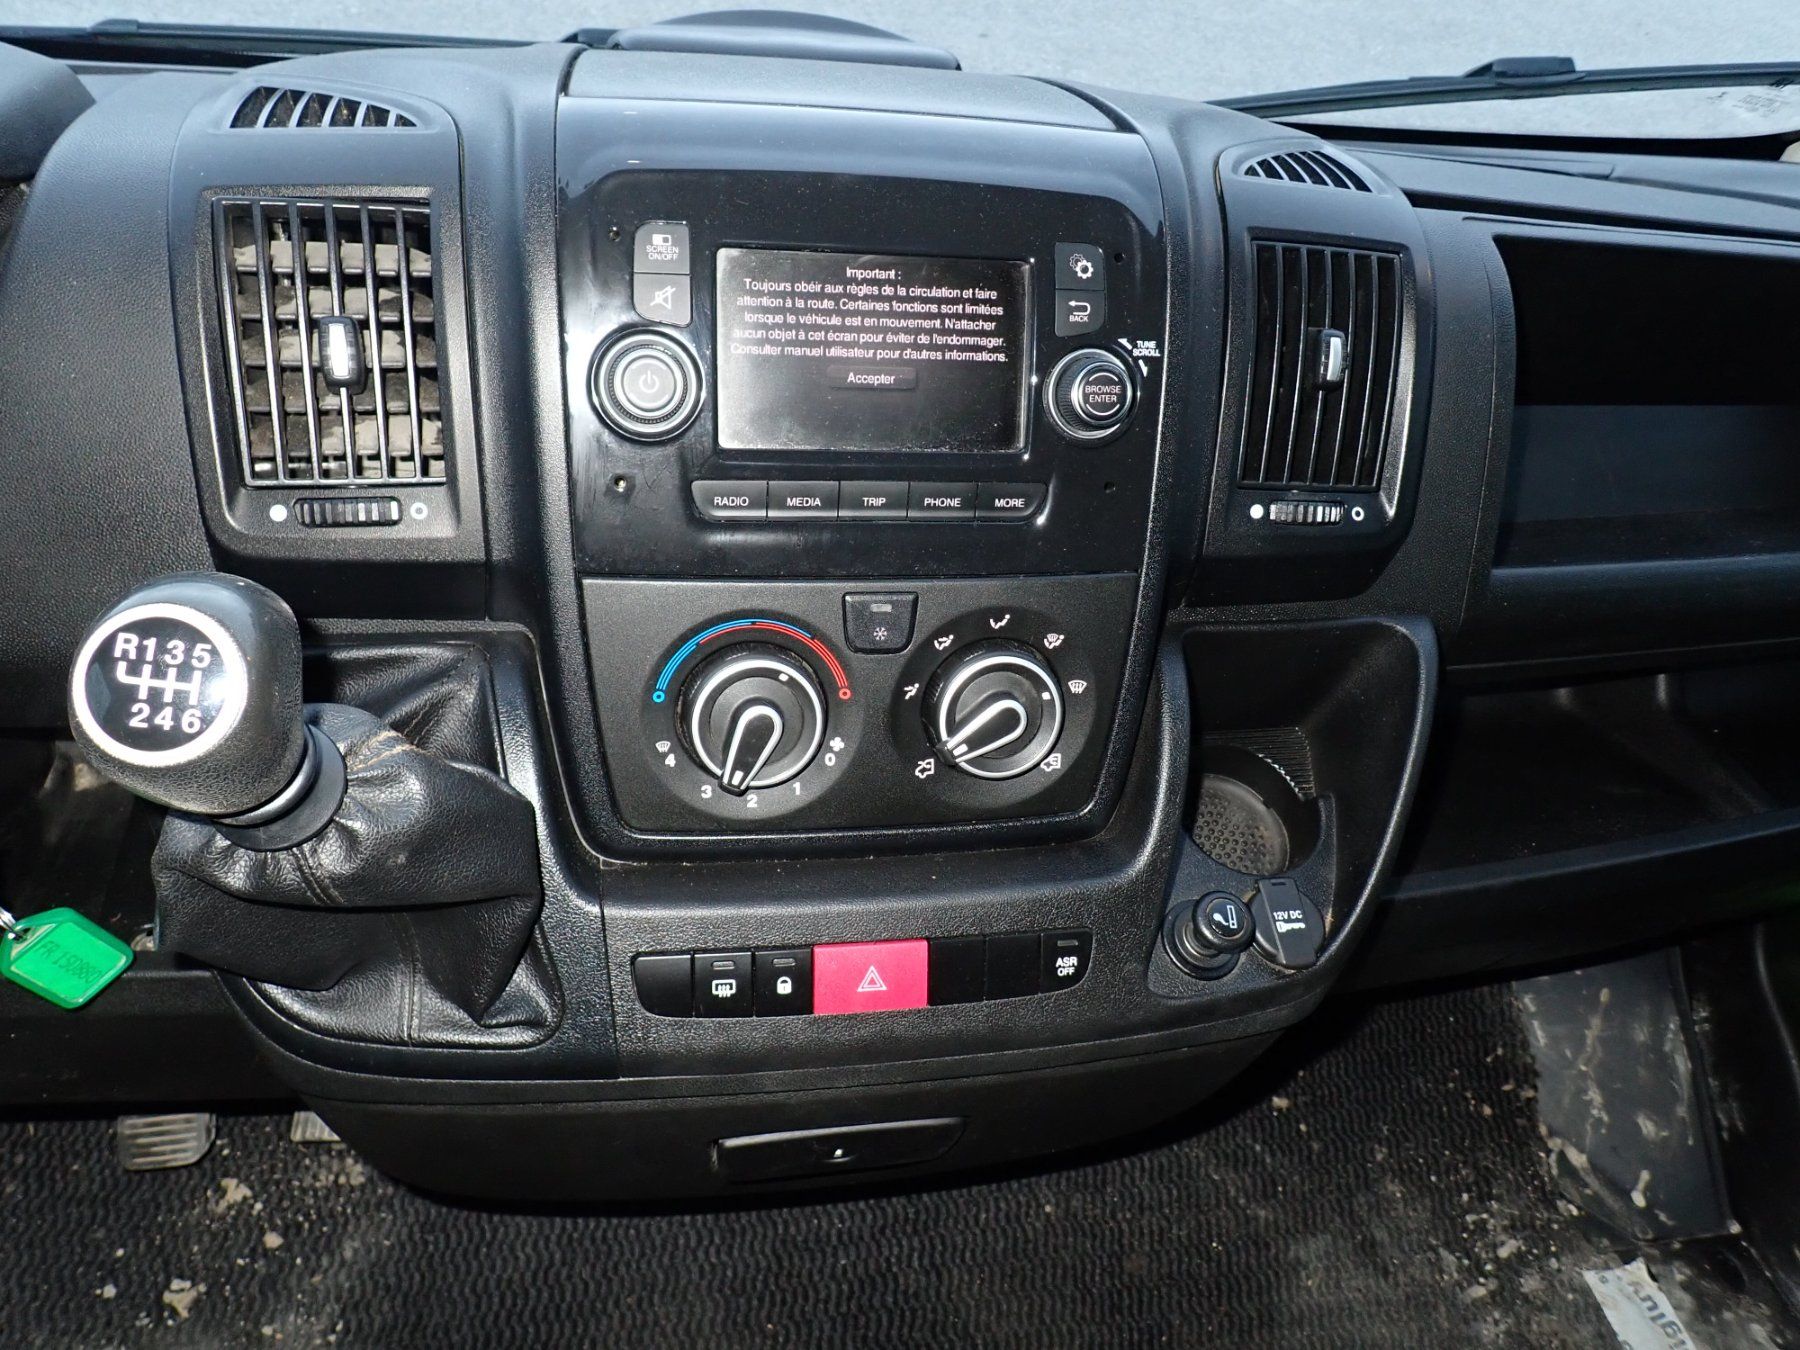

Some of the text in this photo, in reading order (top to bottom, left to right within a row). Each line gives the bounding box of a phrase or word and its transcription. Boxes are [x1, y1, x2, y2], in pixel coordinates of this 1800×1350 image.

[646, 245, 679, 254] SCREEN
[648, 252, 679, 261] ON/OFF
[846, 267, 895, 281] Important
[743, 278, 998, 300] Toujours obéir aux règles de la circulation et faire
[737, 296, 1004, 315] attention à la route. Certaines fonctions sont limitées
[744, 311, 996, 331] lorsque le véhicule est en mouvement. N'attacher
[1069, 314, 1089, 323] BACK
[733, 328, 1006, 348] aucun objet à cet écran pour éviter de l'endommager.
[1136, 340, 1157, 349] TUNE
[730, 343, 1009, 362] Consulter manuel utilisateur pour d'autres informations.
[1132, 348, 1161, 357] SCROLL
[847, 372, 895, 386] Accepter
[1085, 385, 1122, 394] BROWSE
[1089, 394, 1117, 403] ENTER
[713, 496, 749, 507] RADIO
[786, 497, 821, 507] MEDIA
[862, 497, 886, 507] TRIP
[924, 497, 961, 508] PHONE
[994, 498, 1025, 508] MORE
[164, 639, 185, 665] 3
[191, 643, 212, 668] 5
[128, 702, 202, 734] 2 4 6
[664, 753, 676, 767] 4
[824, 752, 836, 767] 0
[701, 784, 712, 799] 3
[792, 782, 801, 796] 1
[746, 794, 757, 808] 2
[1273, 910, 1303, 920] 12V DC
[1055, 956, 1078, 968] ASR
[1057, 966, 1075, 977] OFF
